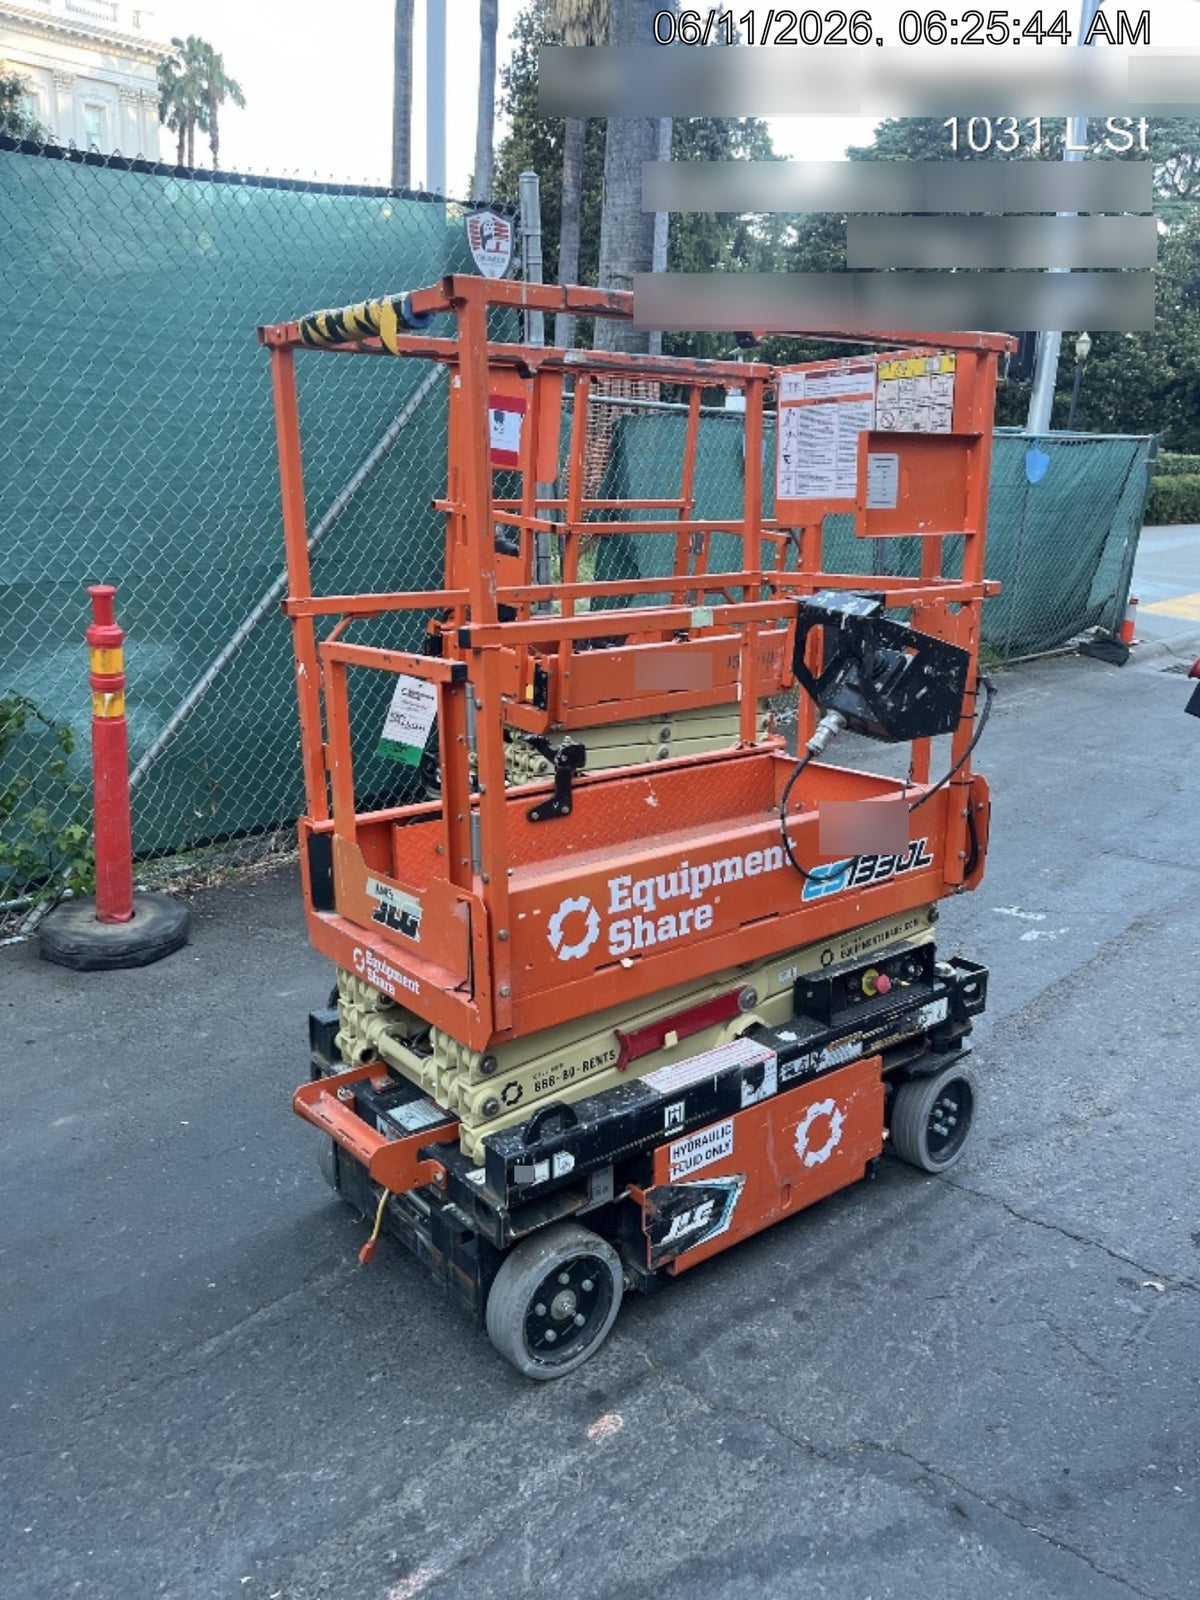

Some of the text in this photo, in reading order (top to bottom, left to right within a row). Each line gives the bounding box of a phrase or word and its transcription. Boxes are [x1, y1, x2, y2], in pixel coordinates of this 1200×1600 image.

[608, 904, 713, 955] Share
[366, 948, 420, 994] Equipment
[368, 967, 396, 996] Share
[672, 1125, 732, 1160] HYDRAULIC
[705, 1139, 732, 1161] ONLY
